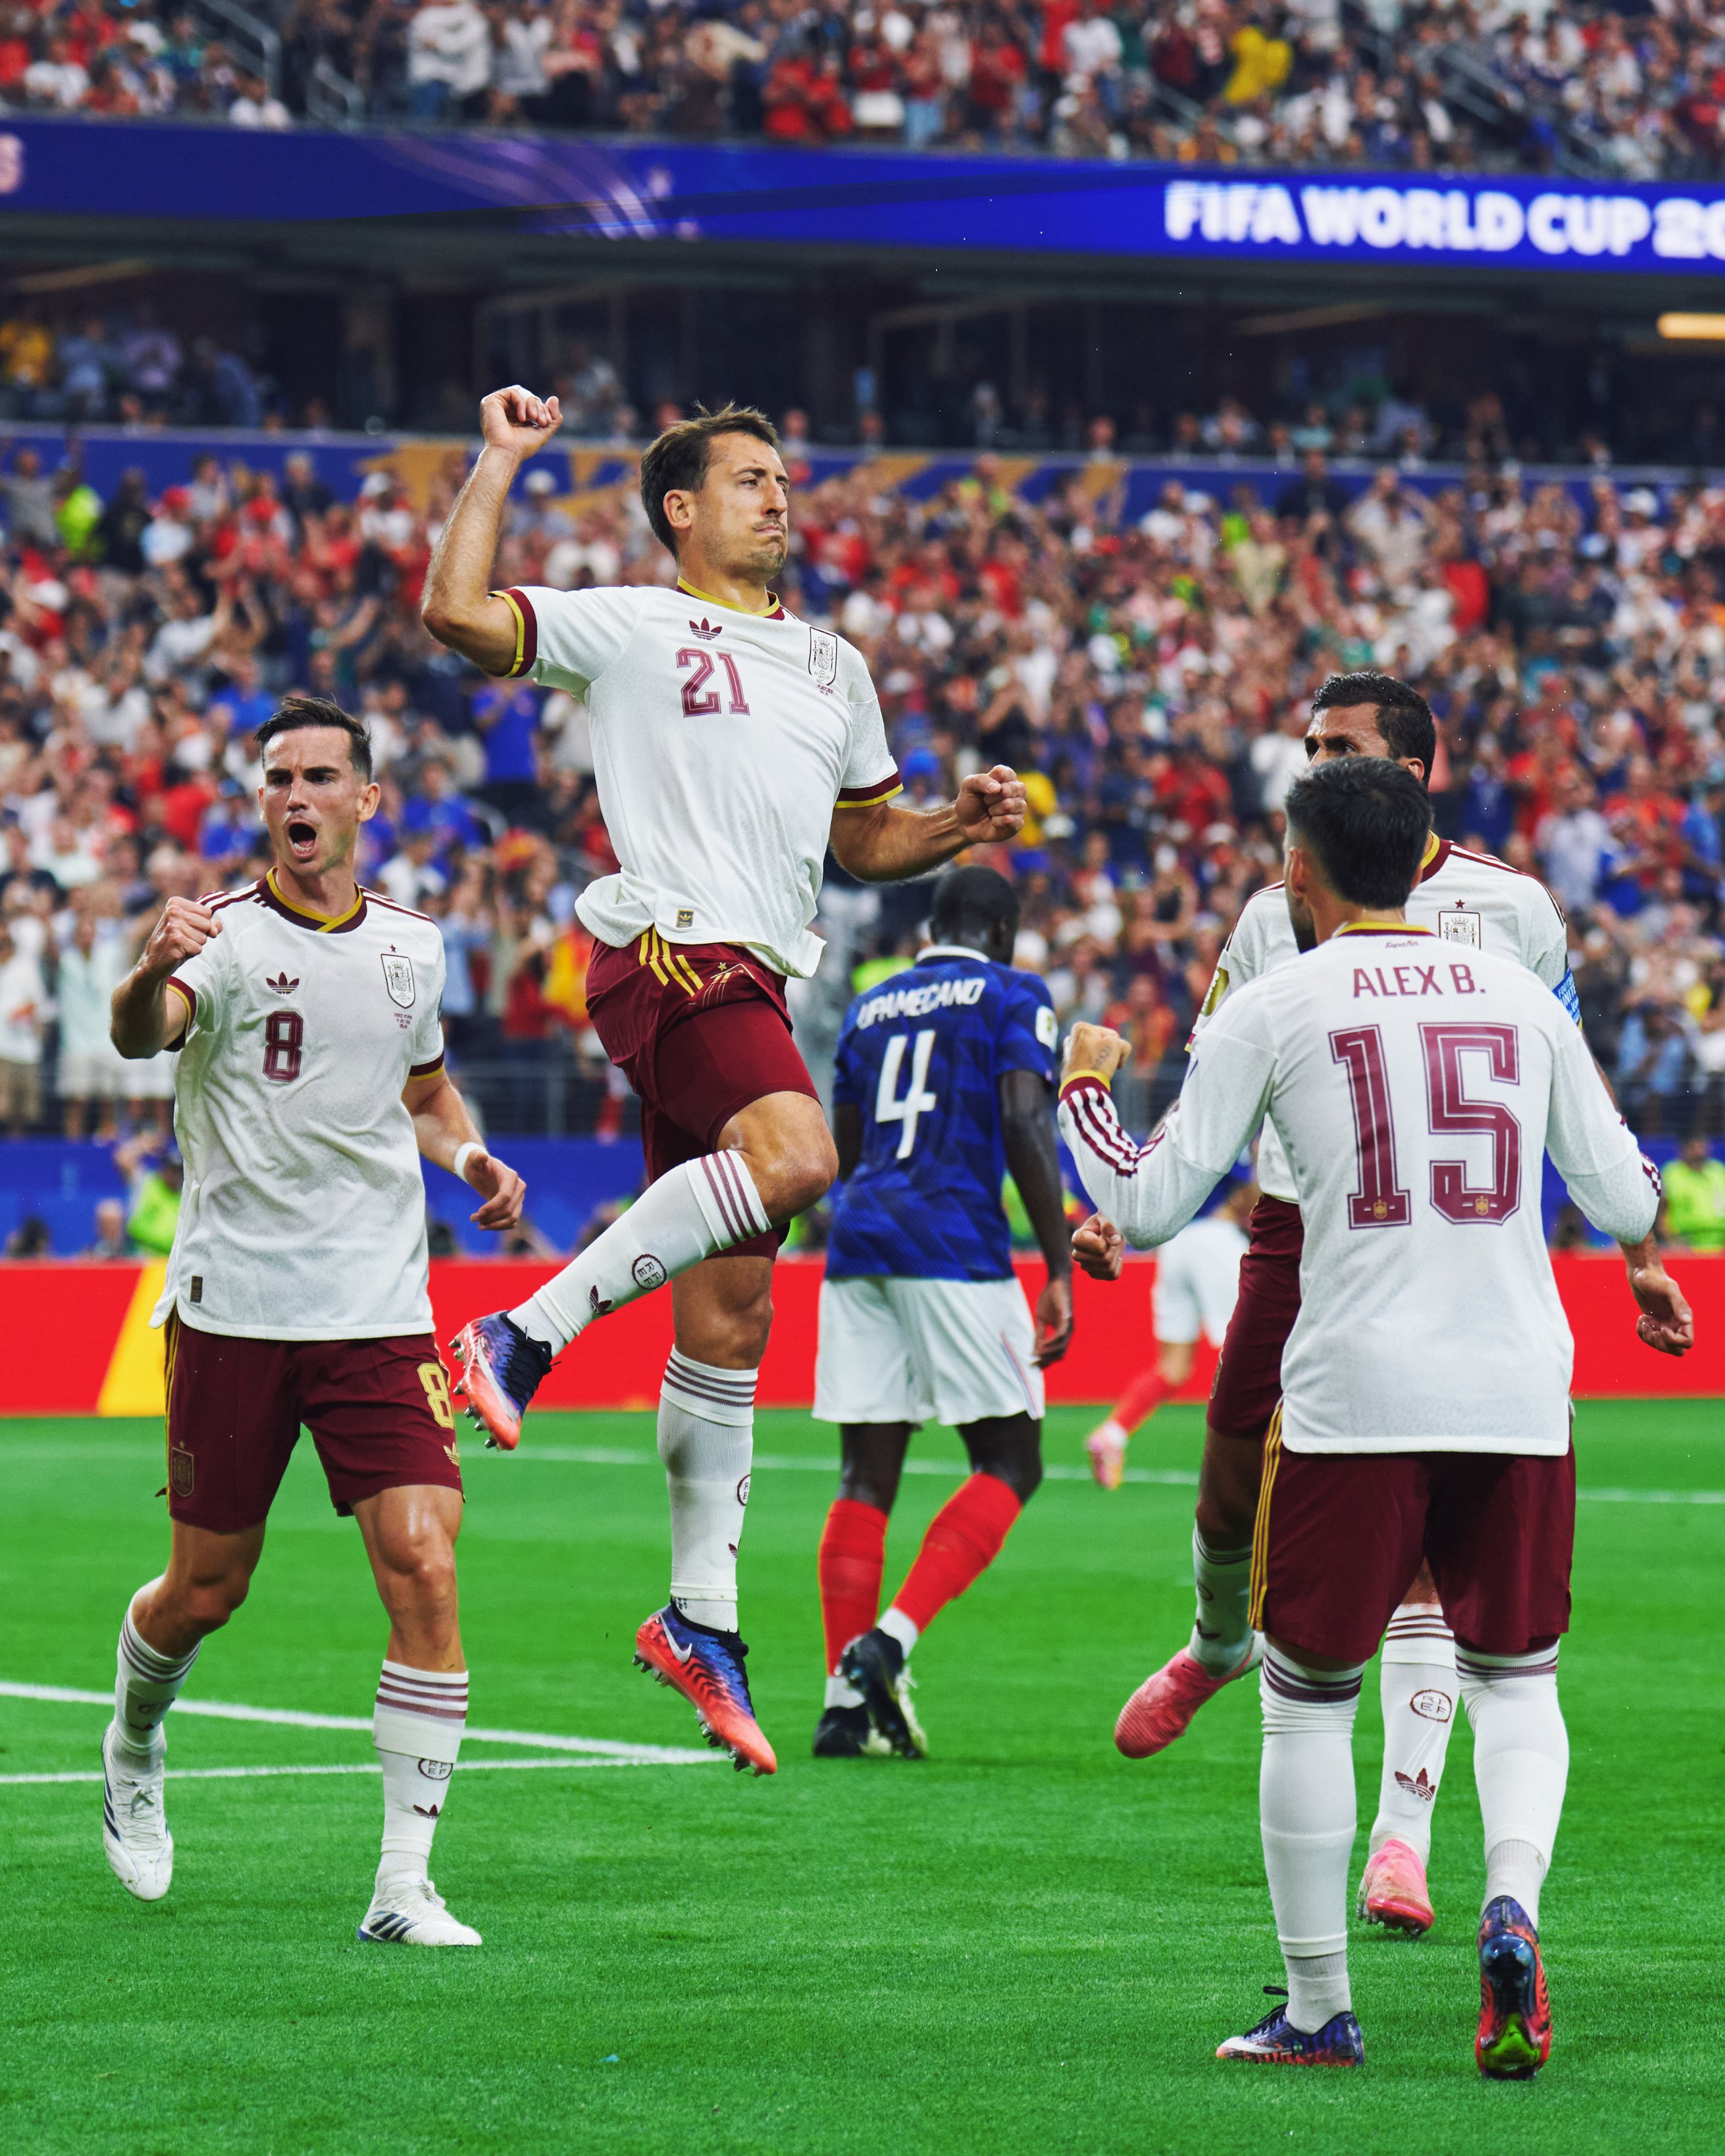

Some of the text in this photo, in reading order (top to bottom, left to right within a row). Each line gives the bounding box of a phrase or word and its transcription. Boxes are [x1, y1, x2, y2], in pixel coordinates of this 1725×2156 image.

[1165, 182, 1302, 244] FIFA
[1301, 185, 1525, 251] WORLD
[1527, 192, 1652, 256] CUP
[675, 647, 750, 717] 21
[856, 977, 987, 1030] UPAMECANO
[1353, 963, 1486, 998] ALEX B.
[263, 1011, 303, 1083] 8
[875, 1029, 937, 1160] 4
[1328, 1022, 1522, 1230] 15
[417, 1362, 454, 1430] 8
